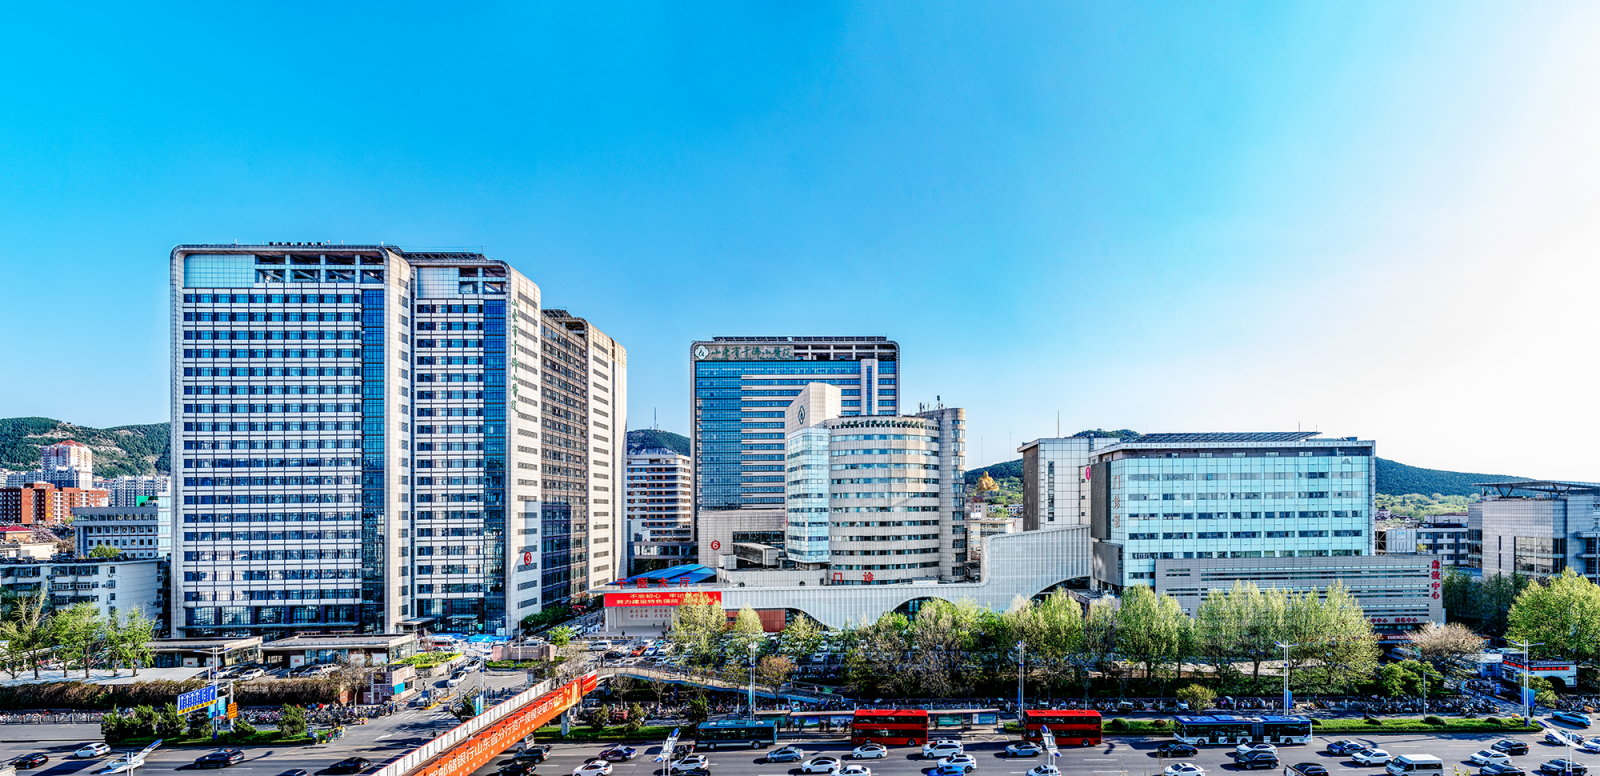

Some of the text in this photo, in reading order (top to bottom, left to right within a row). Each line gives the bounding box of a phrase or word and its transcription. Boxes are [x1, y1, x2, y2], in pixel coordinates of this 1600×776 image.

[616, 576, 691, 589] 千医大厅
[833, 571, 874, 583] 门诊
[1431, 560, 1440, 600] 急救中心
